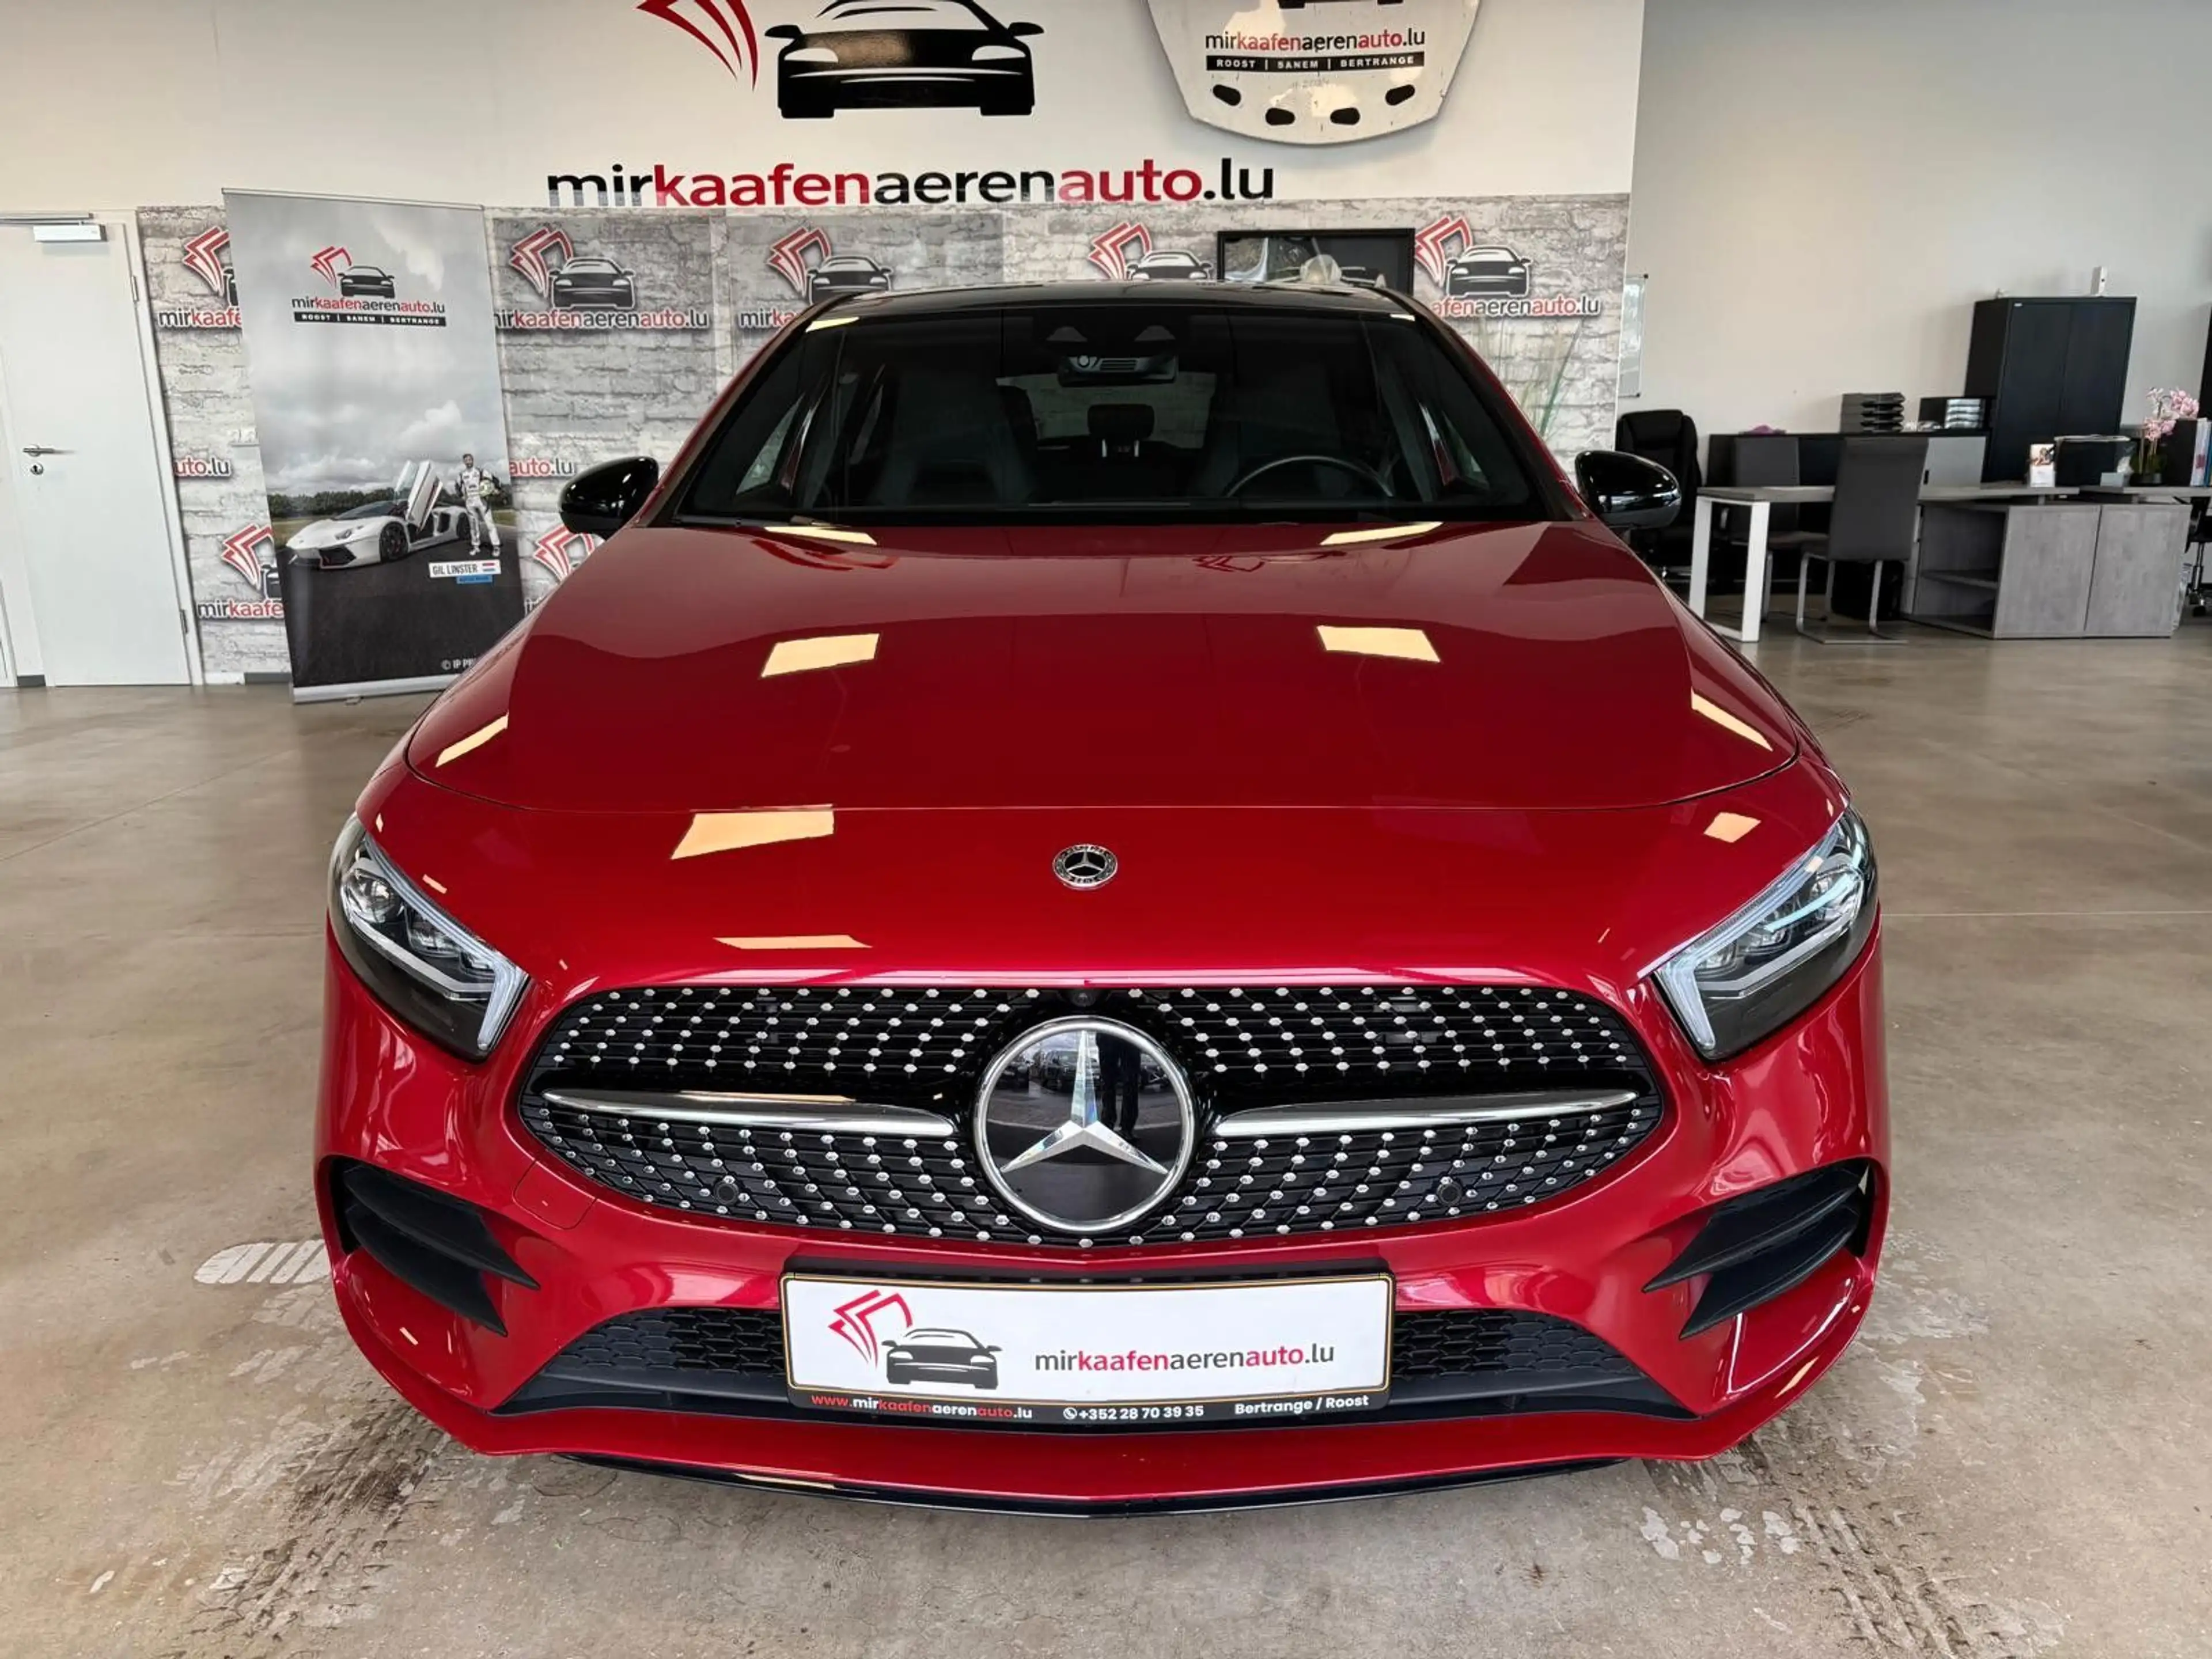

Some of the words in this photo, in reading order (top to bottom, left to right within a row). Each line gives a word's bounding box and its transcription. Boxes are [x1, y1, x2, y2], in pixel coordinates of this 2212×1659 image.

[1206, 28, 1425, 52] mirkaafenaerenauto.lu
[1217, 59, 1256, 69] ROOST
[1278, 60, 1319, 70] SANEM
[1340, 55, 1415, 68] BERTRANGE
[548, 158, 1274, 207] mirkaafenaerenauto.lu
[292, 296, 445, 313] mirkaafenaerenauto.lu
[173, 457, 229, 474] uto.lu
[432, 565, 445, 575] GIL
[1036, 1342, 1335, 1372] mirkaafenaerenauto.lu
[812, 1394, 1032, 1419] www.mirkaafenaerenauto.lu
[1079, 1409, 1116, 1419] +352
[1121, 1408, 1138, 1419] 28
[1142, 1408, 1160, 1418] 70
[1164, 1407, 1182, 1418] 39
[1185, 1406, 1204, 1416] 35
[1234, 1401, 1313, 1415] Bertrange
[1325, 1395, 1369, 1409] Roost
